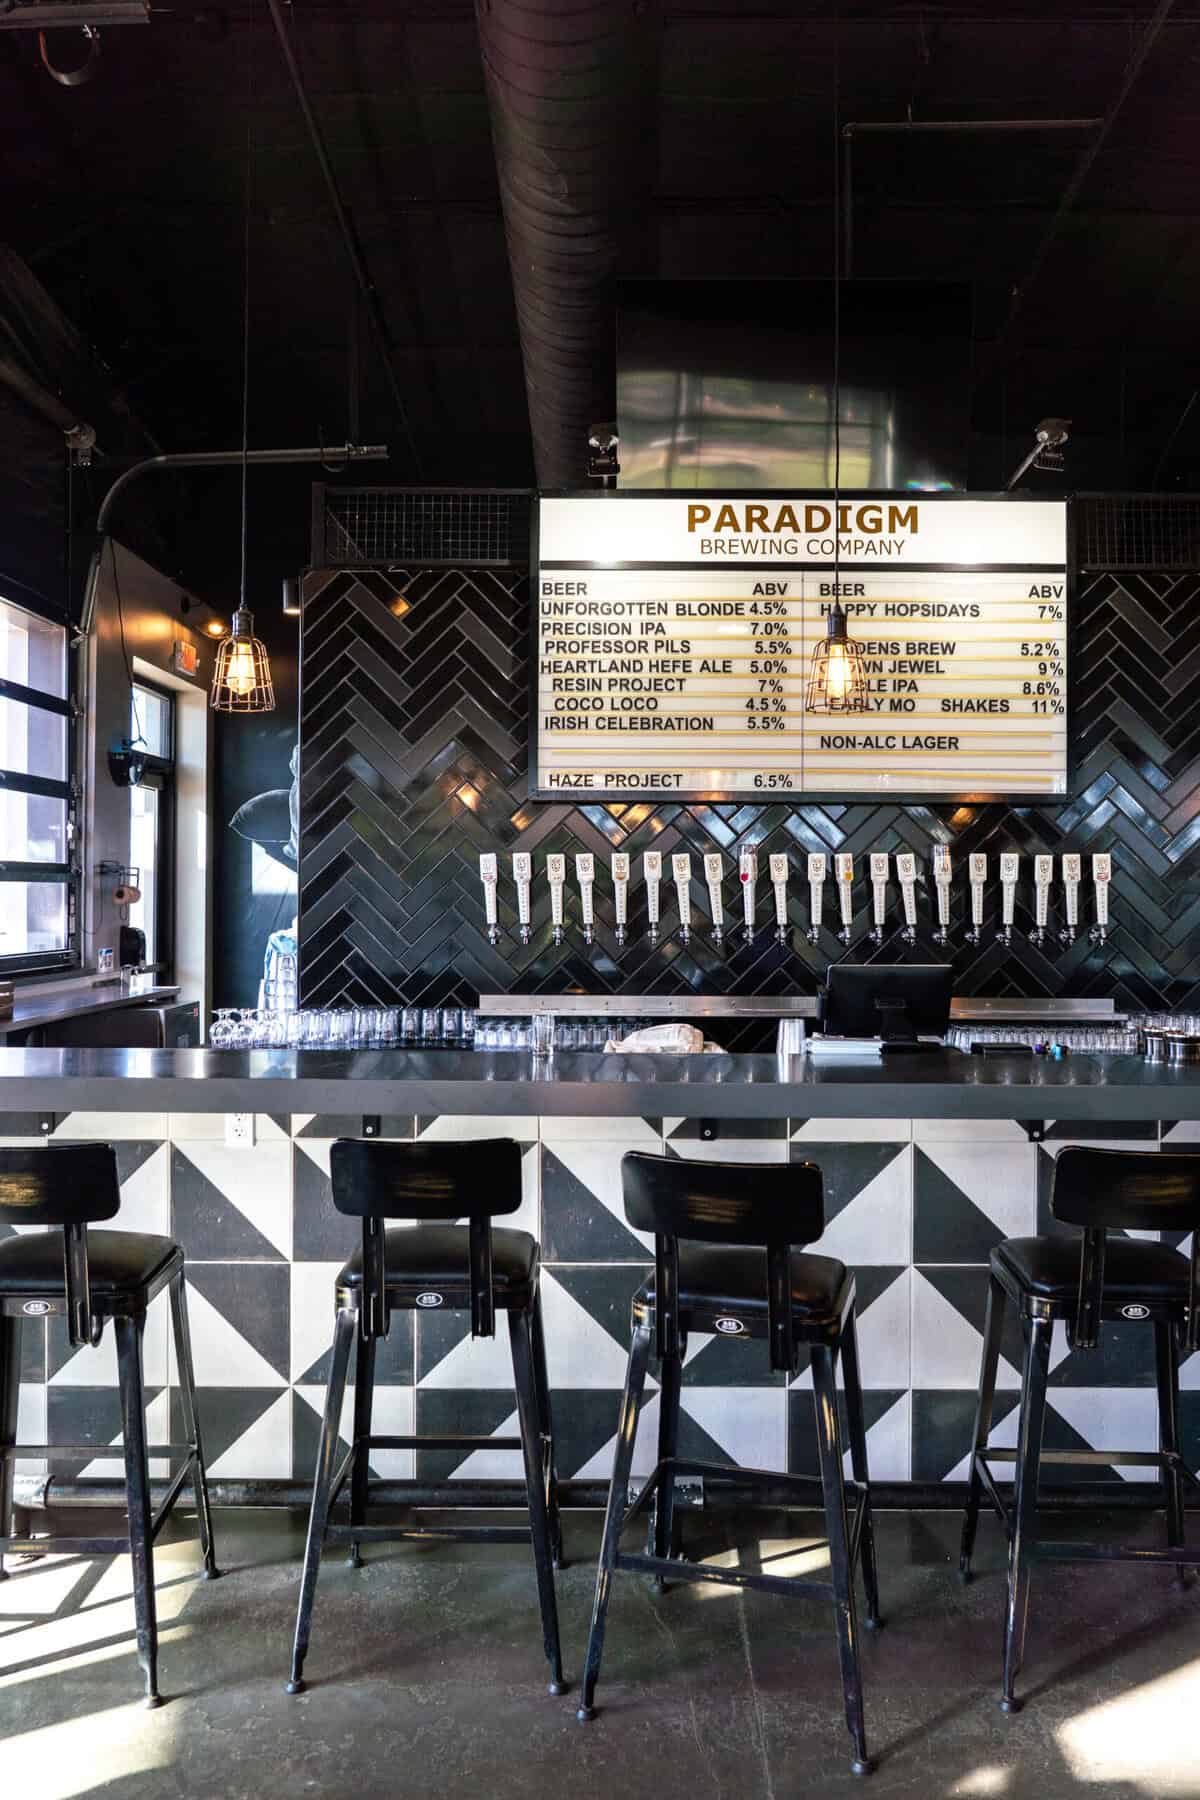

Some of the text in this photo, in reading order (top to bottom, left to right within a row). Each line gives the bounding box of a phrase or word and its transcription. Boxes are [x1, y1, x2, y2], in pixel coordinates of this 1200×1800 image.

[686, 503, 919, 535] PARADIGM
[699, 538, 905, 556] BREWING COMPANY
[542, 582, 788, 596] BEER ABV
[819, 582, 1064, 599] BEER ABV
[539, 600, 788, 617] UNFORGOTTEN BLONDE 4.5%
[820, 603, 1063, 619] HPPY HOPSIDAYS 7%
[541, 622, 788, 636] PRECISION IPA 7.0%
[545, 639, 792, 655] PROFESSOR PILS 5.5%
[905, 642, 956, 656] BREW
[1020, 643, 1060, 657] 5.2%
[540, 659, 788, 675] HEARTLAND HEFE ALE 5.0%
[888, 659, 946, 674] JEWEL
[1038, 662, 1066, 677] 9%
[552, 677, 783, 693] RESIN PROJECT 7%
[892, 679, 919, 693] IPA
[1022, 681, 1060, 696] 8.6%
[554, 696, 787, 713] COCO LOCO 4.5%
[889, 698, 916, 712] MO
[941, 699, 1010, 713] SHAKES
[1031, 699, 1066, 715] 11%
[544, 716, 785, 731] IRISH CELEBRATION 5.5%
[820, 735, 959, 751] NON-ALC LAGER
[549, 773, 793, 788] HAZE PROJECT 6.5%
